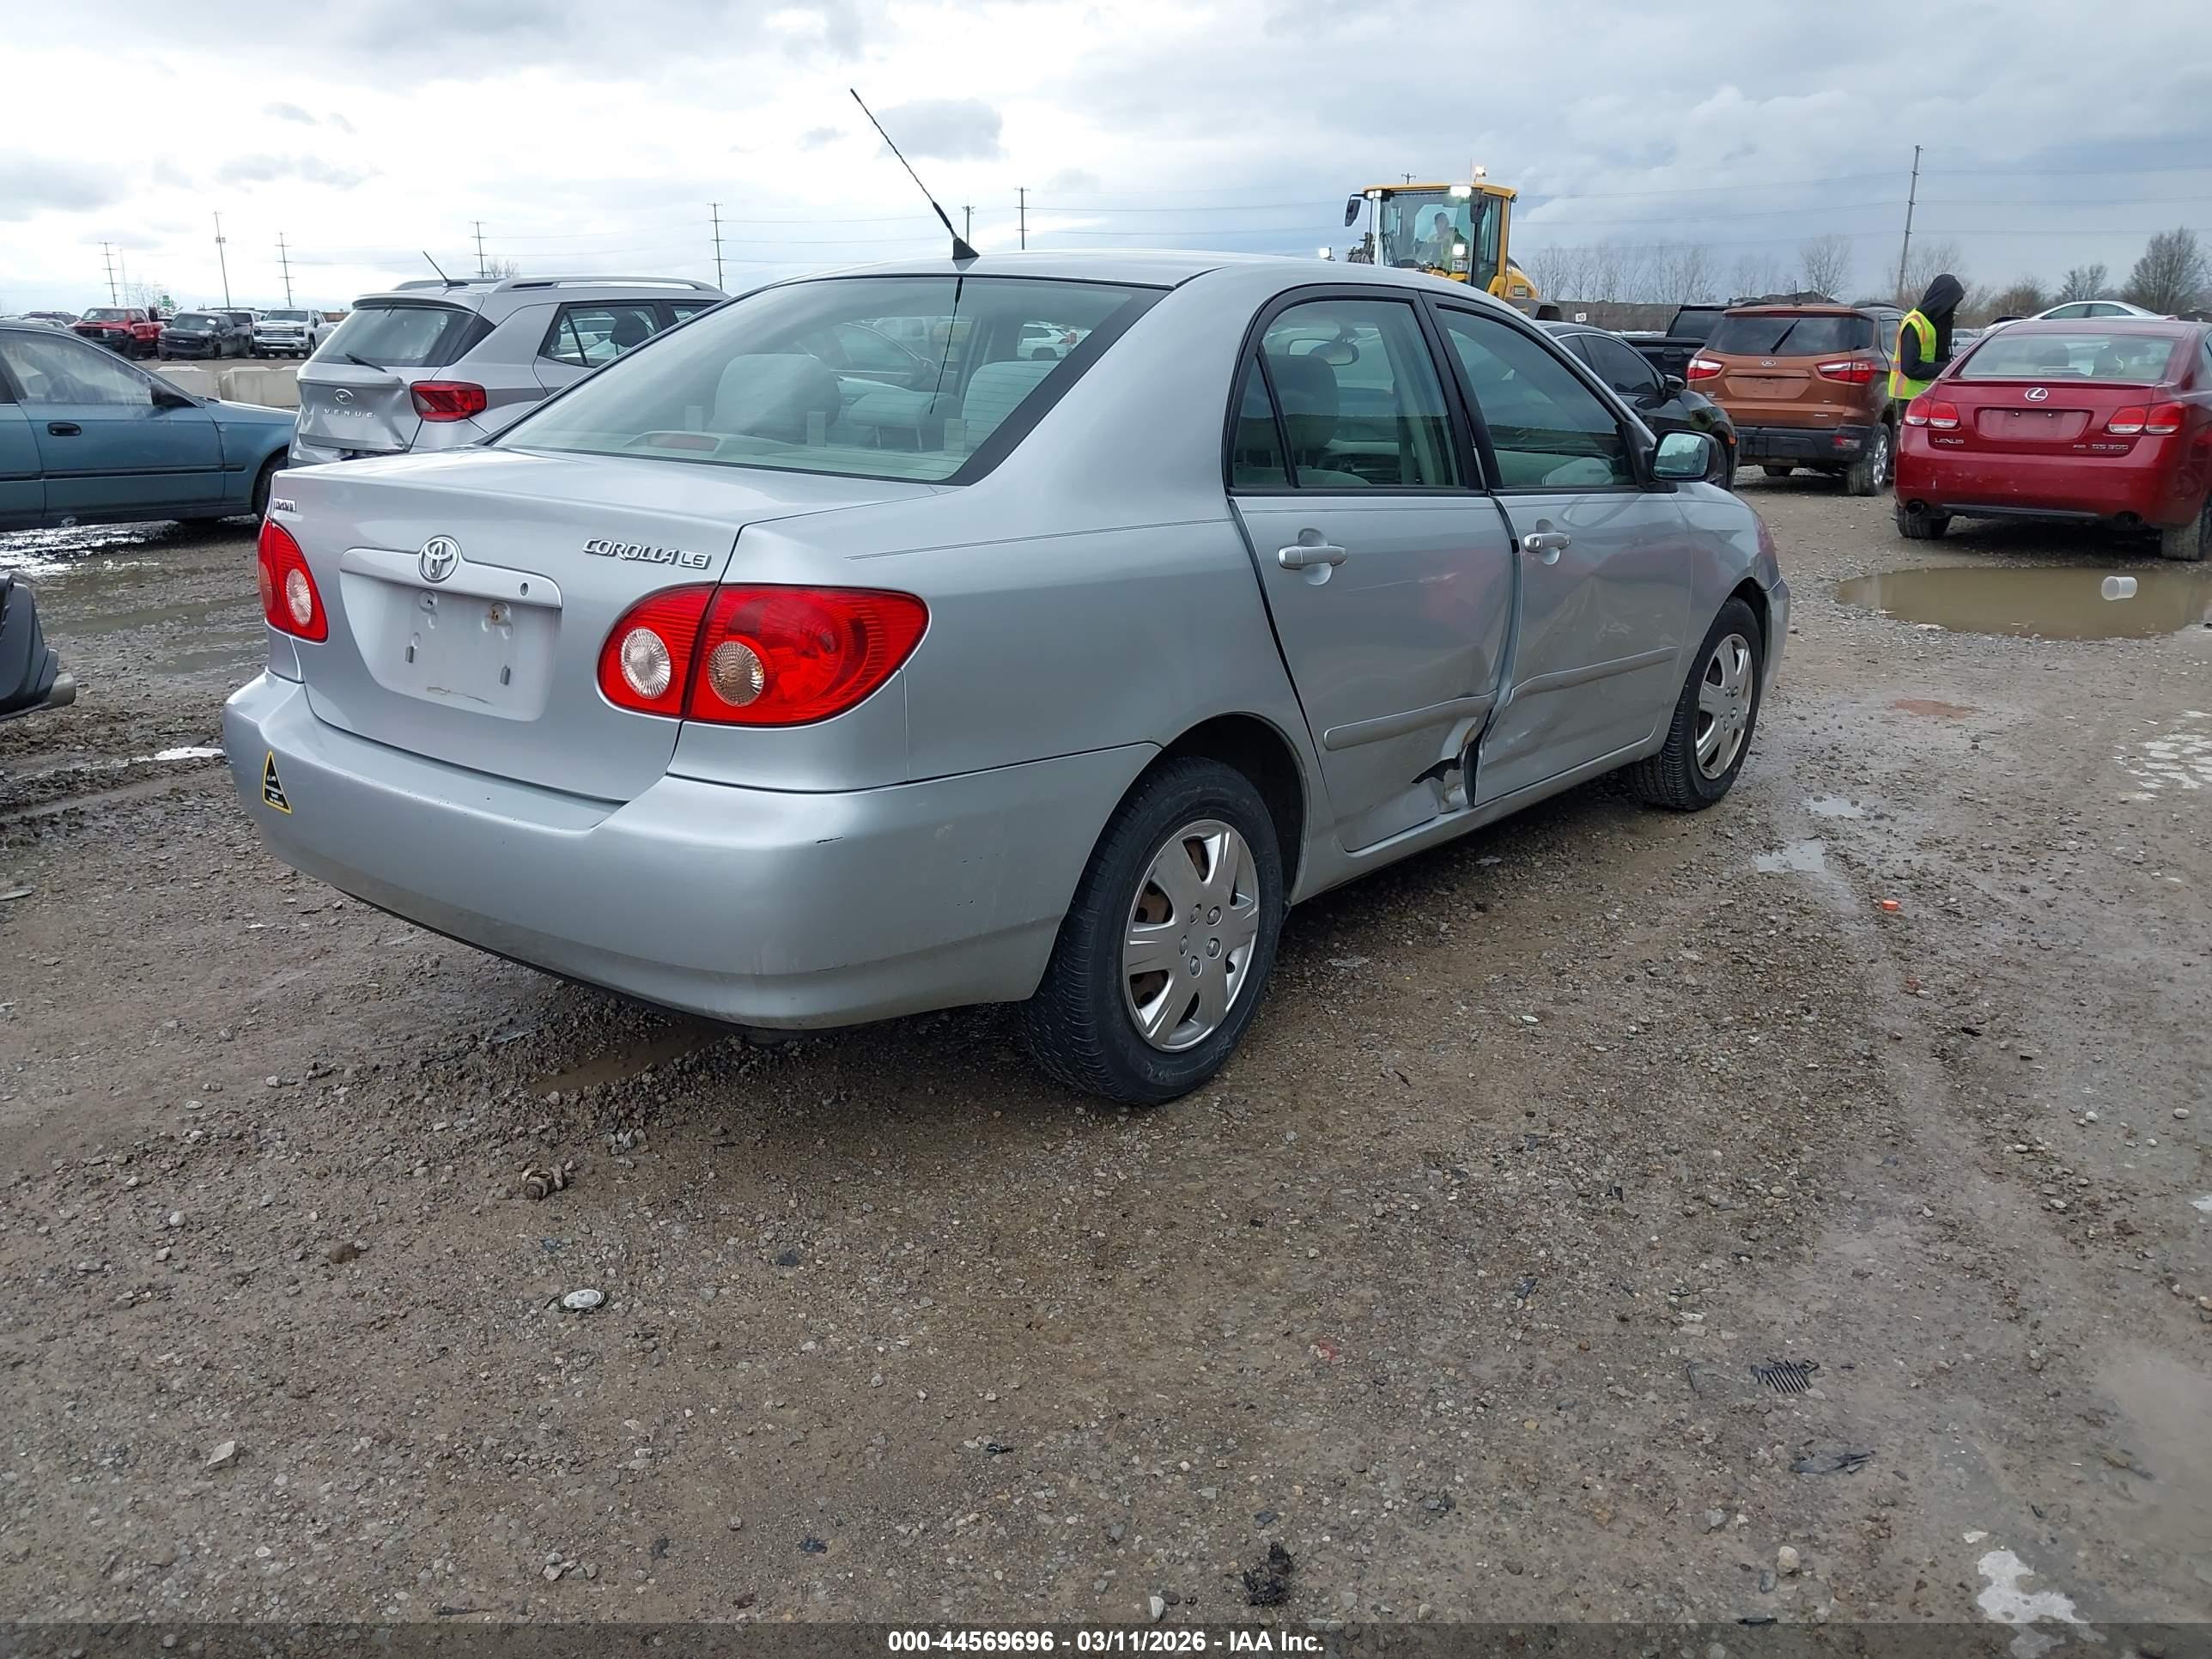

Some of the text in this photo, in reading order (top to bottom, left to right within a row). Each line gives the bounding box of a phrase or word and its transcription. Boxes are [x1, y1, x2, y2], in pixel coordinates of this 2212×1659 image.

[324, 408, 375, 419] VENUE
[582, 538, 709, 568] COROLLA LE
